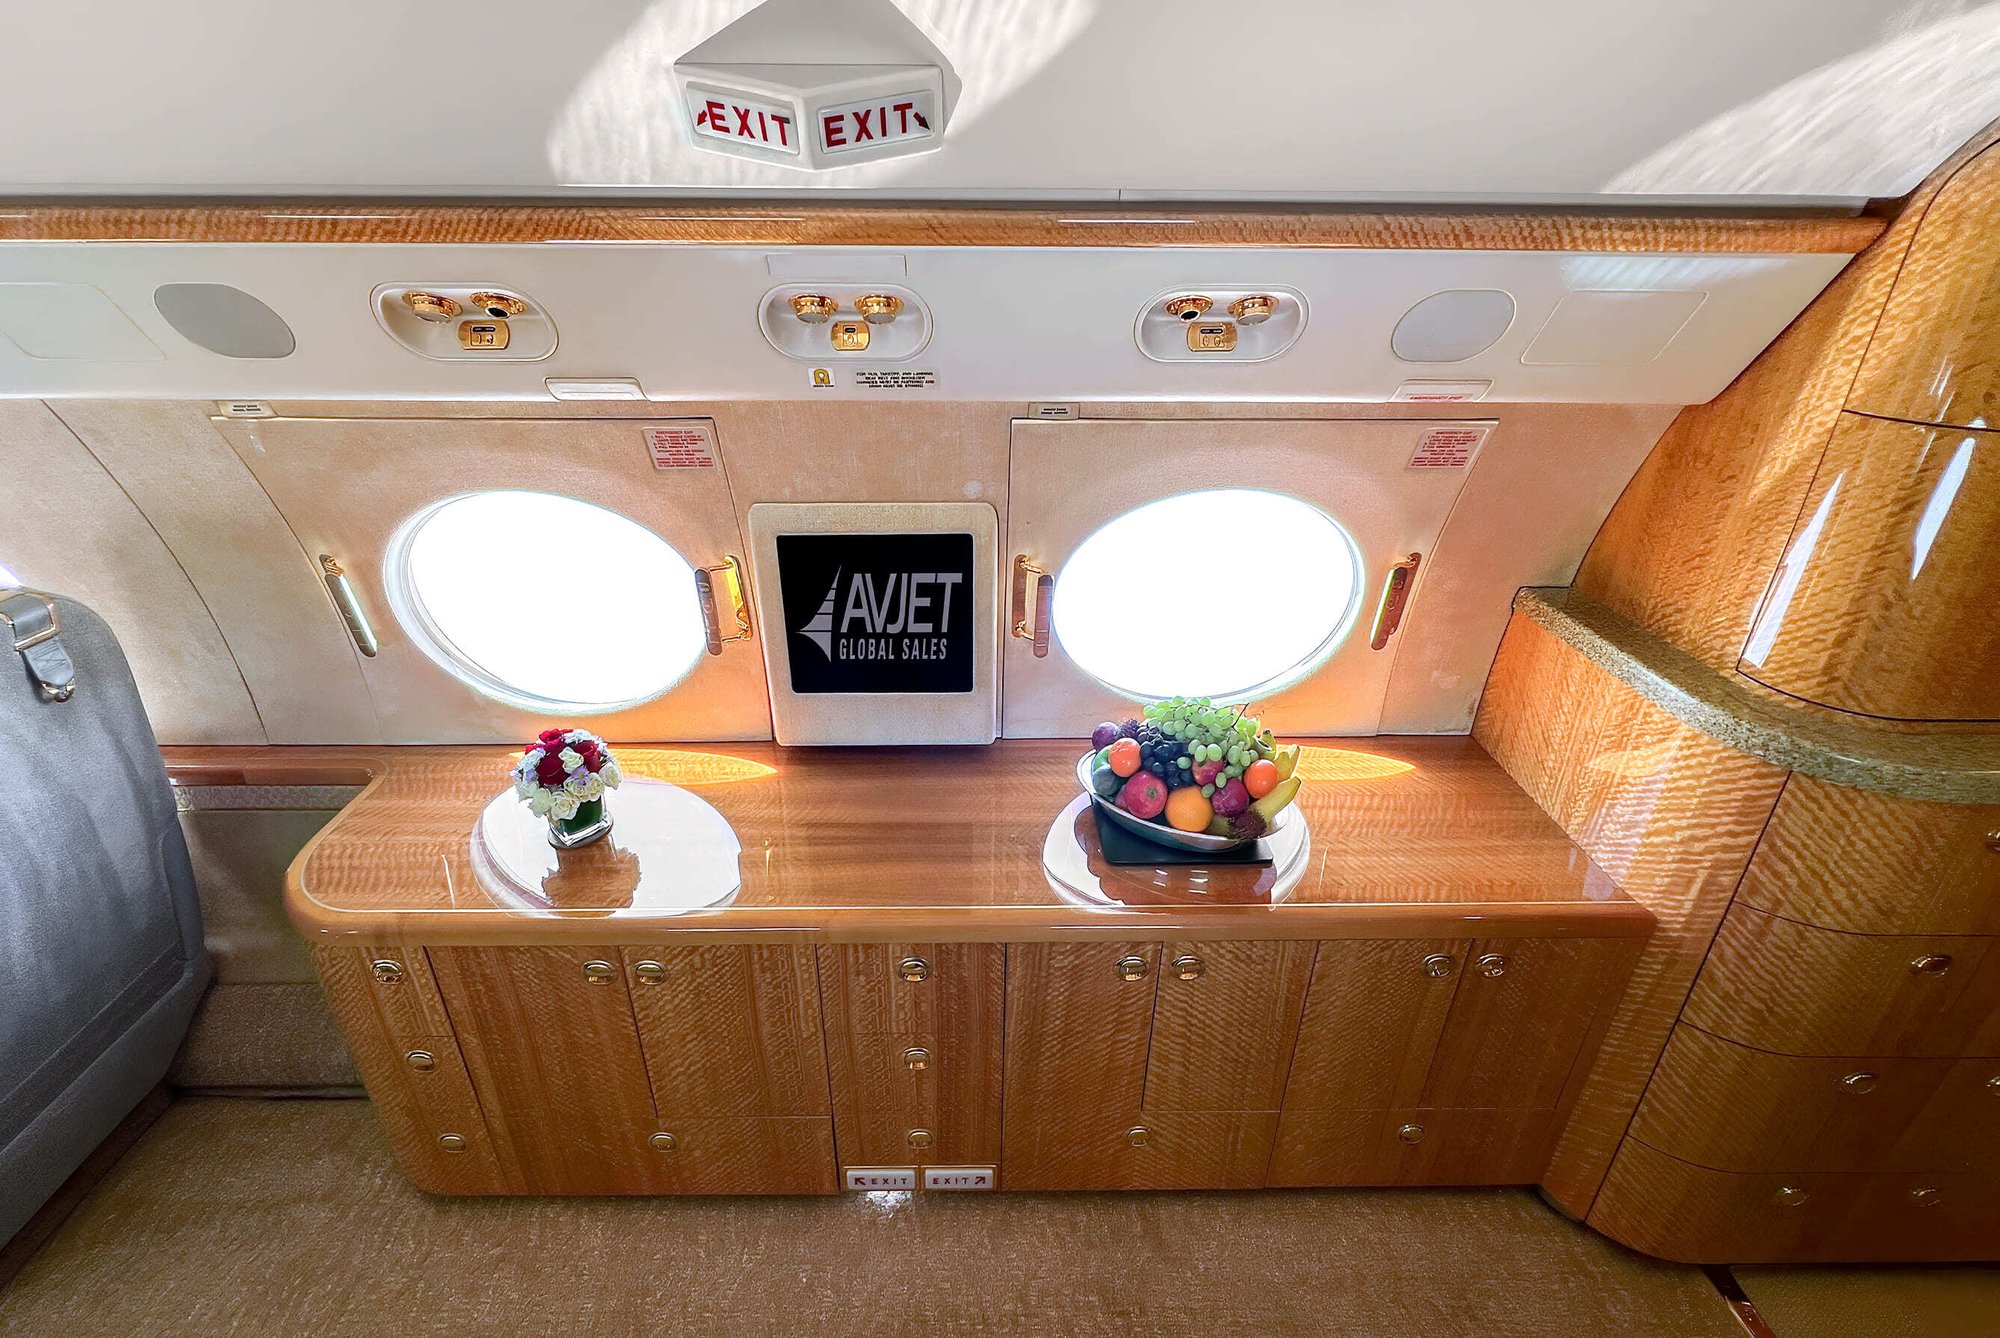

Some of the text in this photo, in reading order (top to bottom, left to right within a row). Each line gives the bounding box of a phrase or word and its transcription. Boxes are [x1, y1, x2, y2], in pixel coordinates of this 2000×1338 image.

[705, 100, 790, 147] EXIT
[823, 102, 913, 148] EXIT
[840, 572, 963, 634] AVJET
[839, 637, 947, 660] GLOBAL SALES
[871, 1177, 908, 1186] EXIT
[932, 1177, 969, 1185] EXIT
